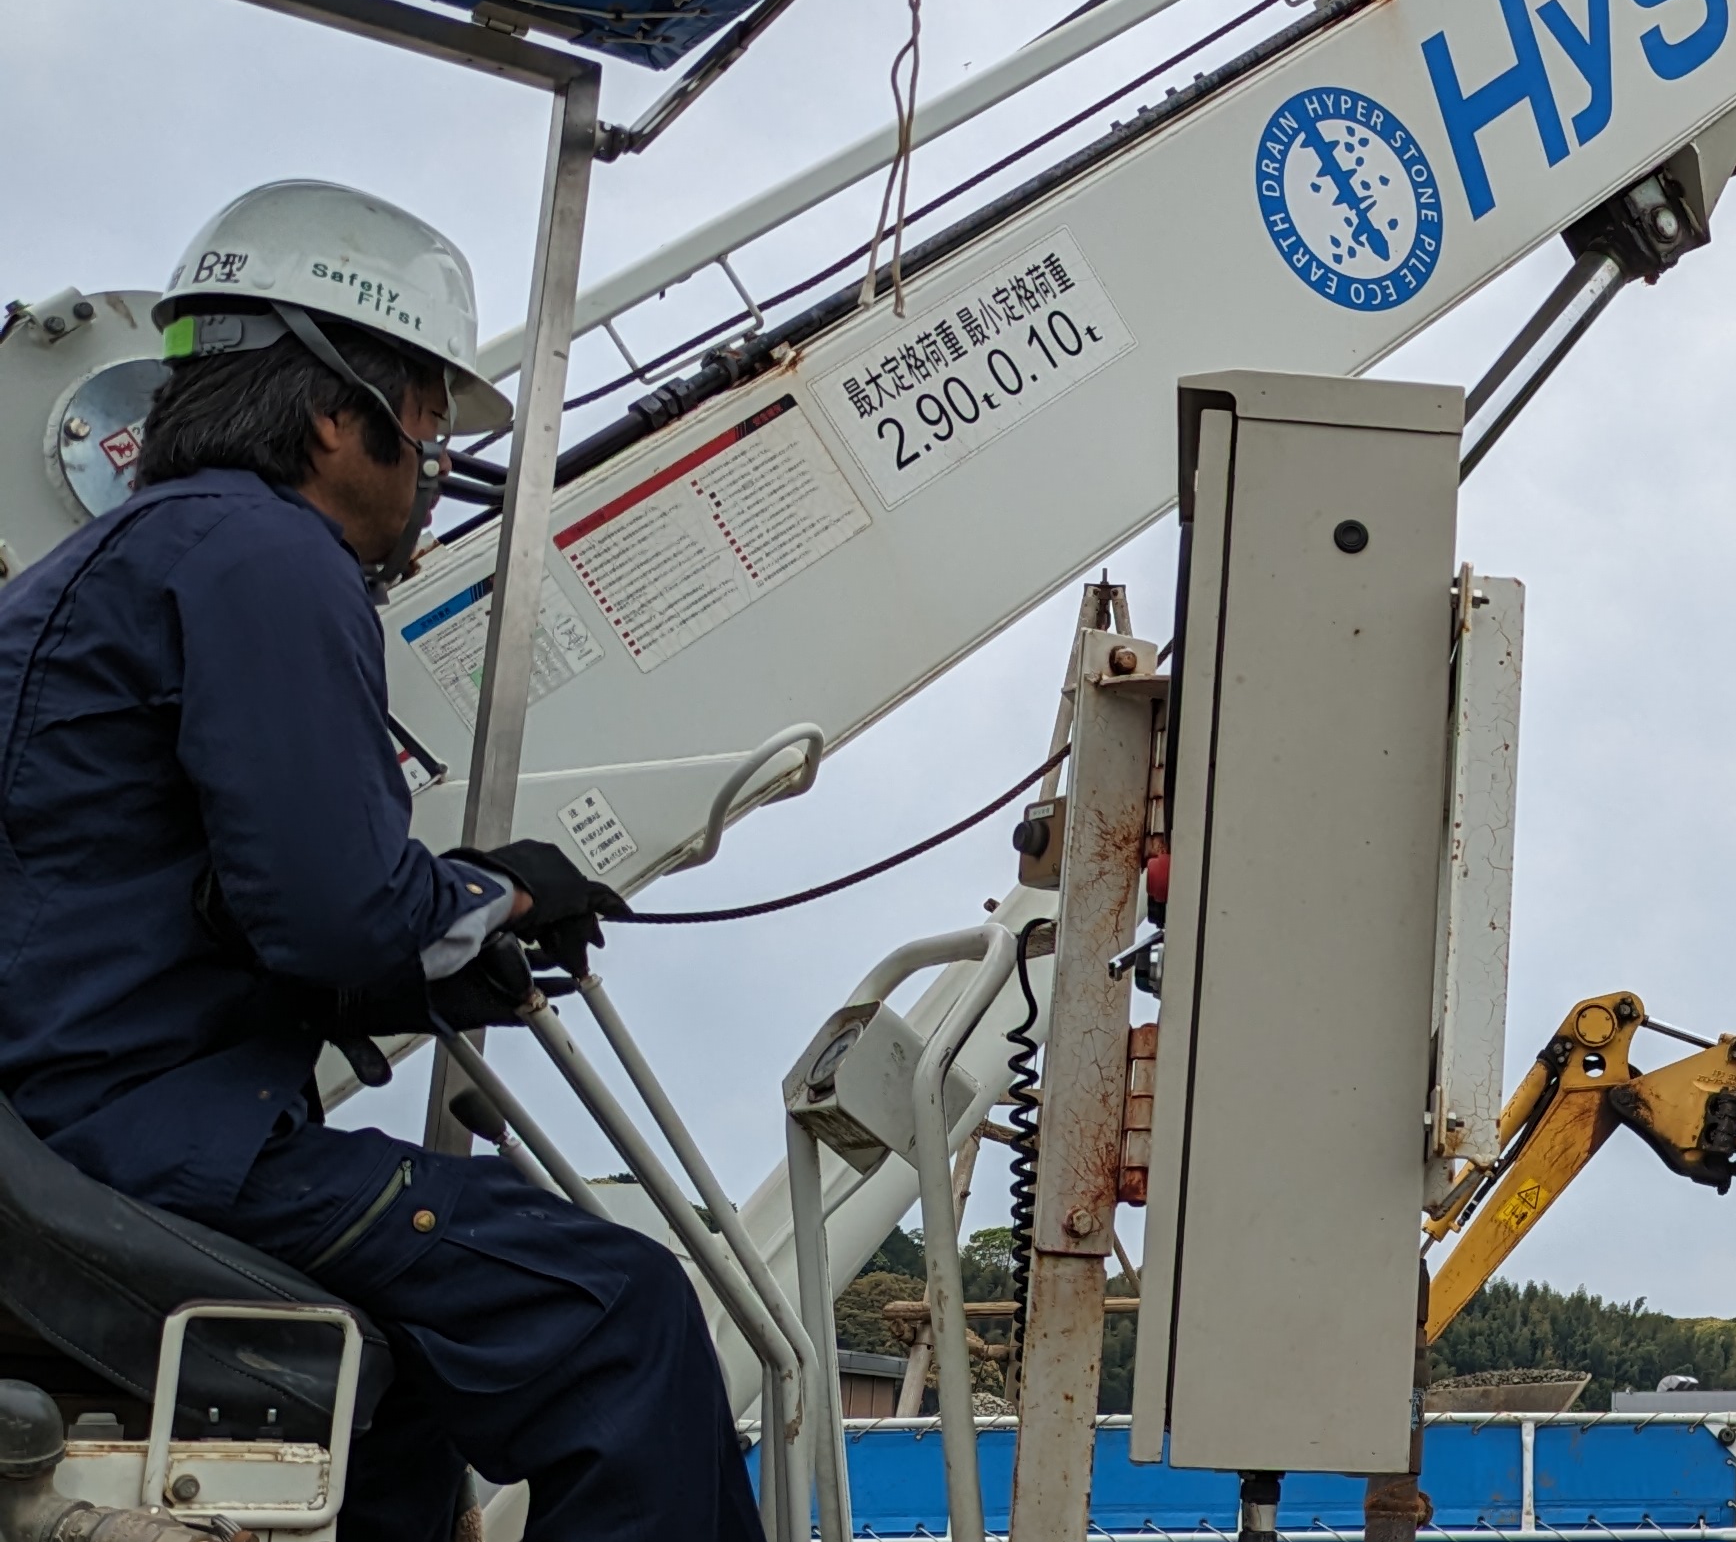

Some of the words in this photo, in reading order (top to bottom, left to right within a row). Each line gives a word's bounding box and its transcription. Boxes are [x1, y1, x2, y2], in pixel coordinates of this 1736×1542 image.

[1304, 93, 1385, 131] HYPER
[1261, 110, 1299, 197] DRAIN
[1390, 130, 1438, 223] STONE
[1268, 212, 1339, 295] EARTH
[1399, 233, 1436, 289] PILE
[311, 262, 400, 303] Safety
[1350, 279, 1398, 305] ECO
[357, 291, 423, 332] First
[842, 319, 969, 419] 最大定格荷重
[955, 252, 1076, 348] 最小定格荷重
